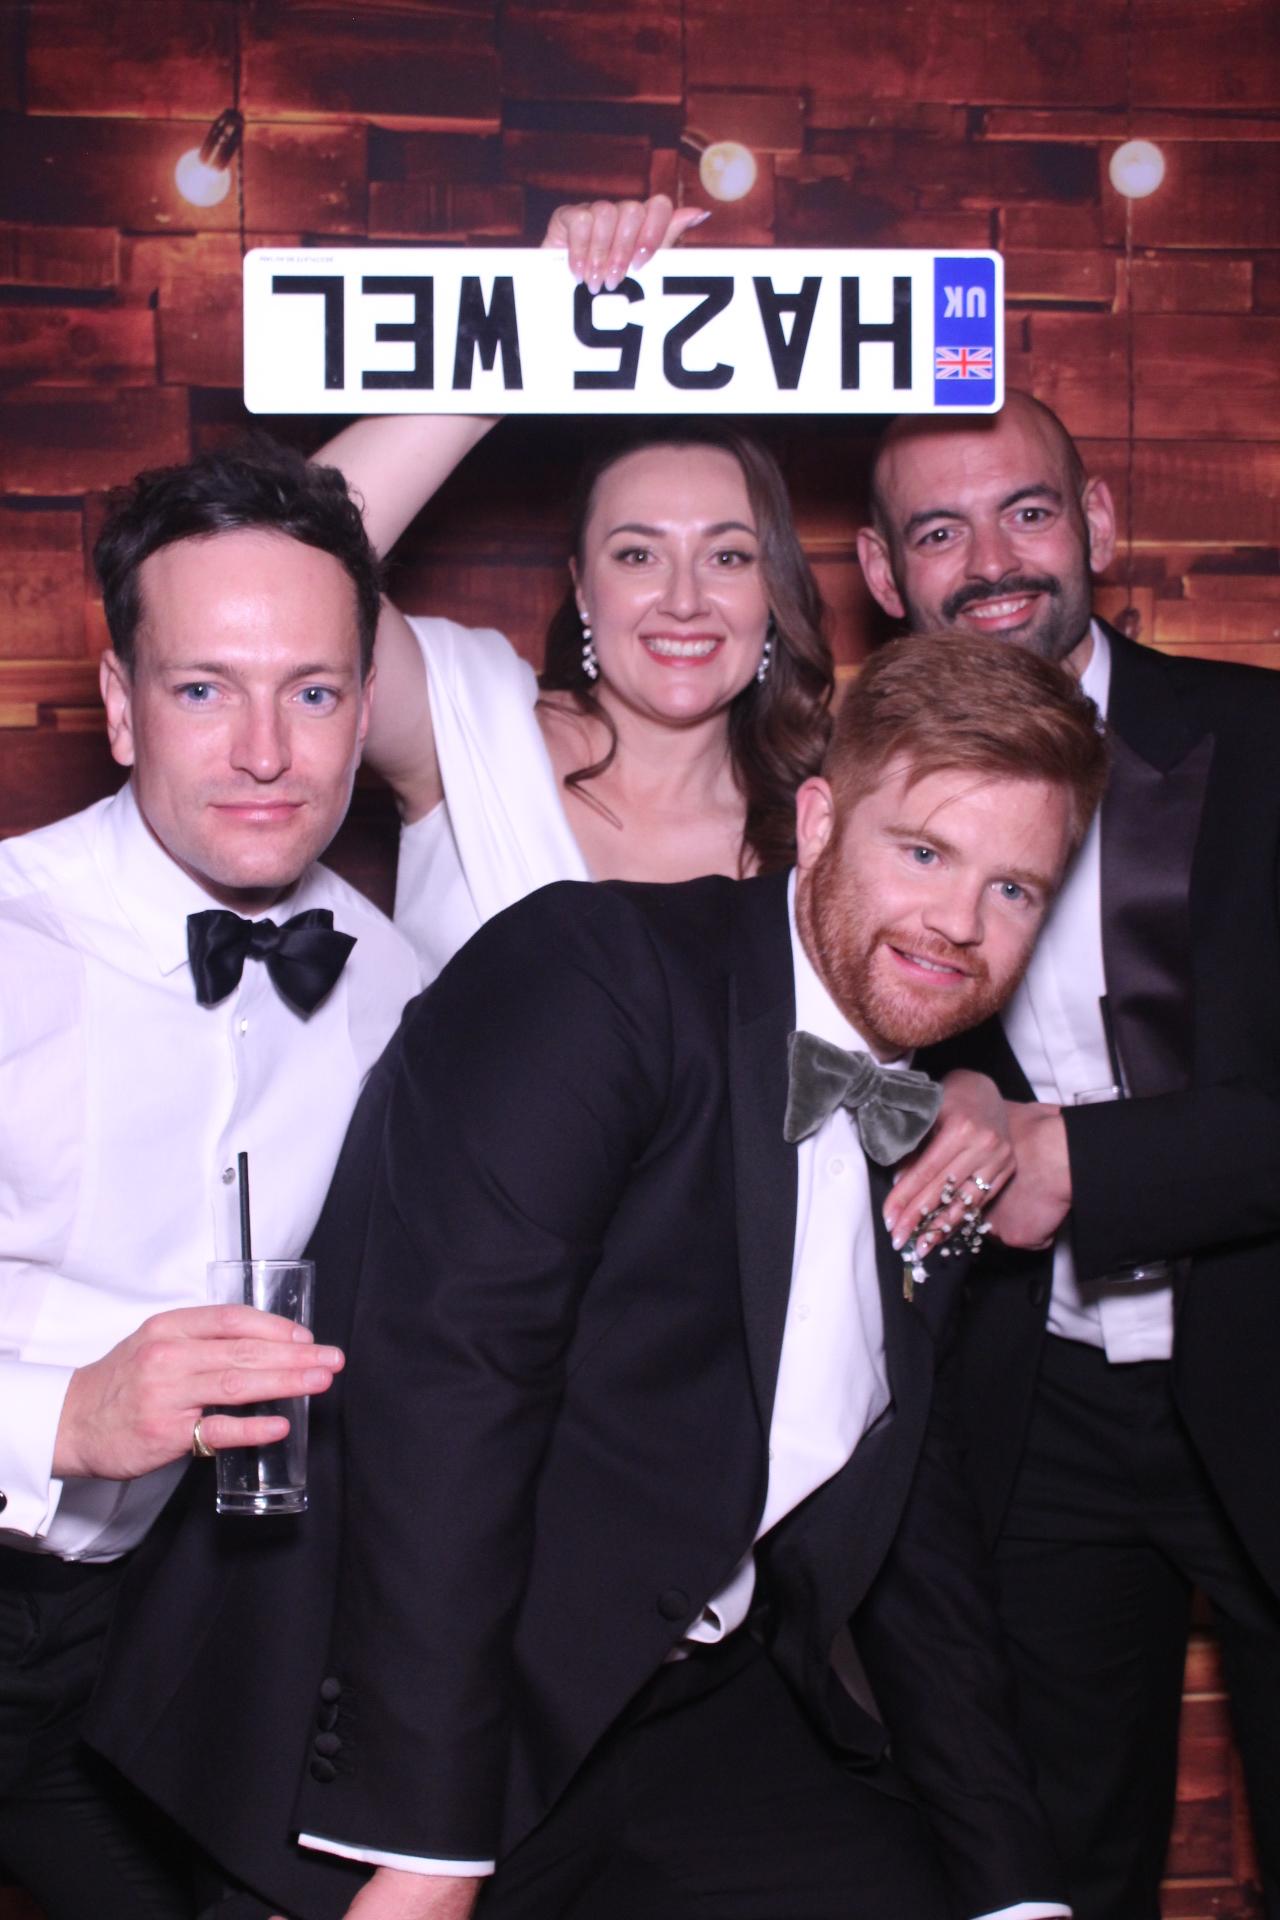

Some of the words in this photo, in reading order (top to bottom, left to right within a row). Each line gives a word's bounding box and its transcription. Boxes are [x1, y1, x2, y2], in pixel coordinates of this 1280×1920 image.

[271, 275, 524, 390] WEL
[573, 275, 913, 390] HA25
[943, 285, 987, 318] UK
